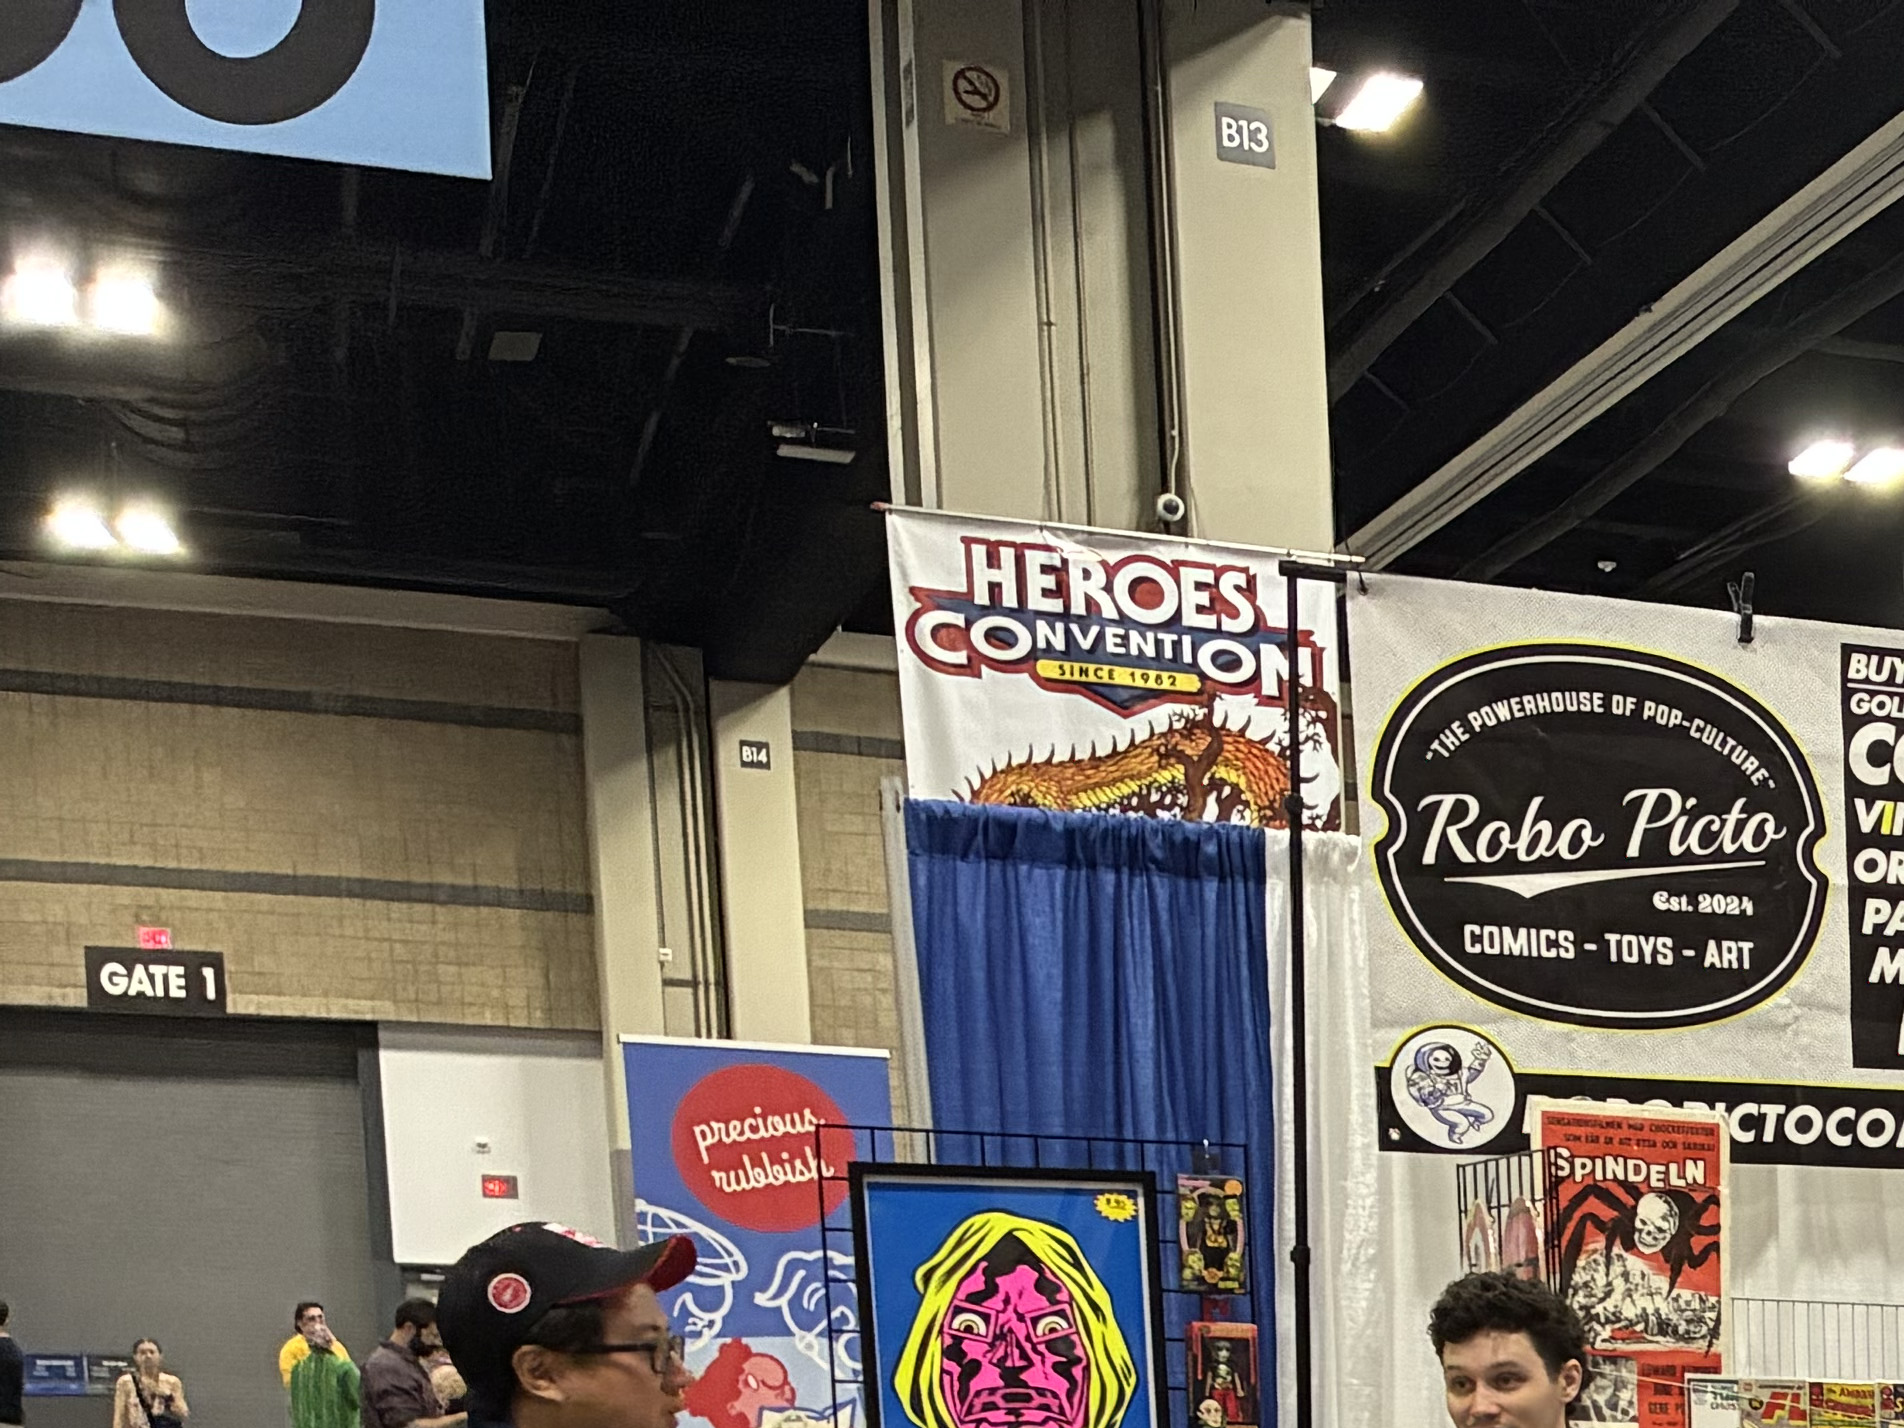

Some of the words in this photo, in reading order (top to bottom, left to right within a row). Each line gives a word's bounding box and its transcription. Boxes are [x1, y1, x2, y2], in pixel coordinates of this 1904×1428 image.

[1221, 116, 1270, 154] B13
[970, 542, 1258, 634] HEROES
[911, 607, 1314, 698] CONVENTION
[1058, 663, 1115, 682] SINCE
[1130, 670, 1178, 687] 1982
[1465, 690, 1604, 736] POWERHOUSE
[1611, 691, 1634, 716] OF
[742, 745, 767, 765] B14
[1416, 793, 1604, 866] Robo
[1622, 785, 1788, 859] Picto
[1652, 890, 1693, 914] Est.
[1463, 923, 1576, 958] COMICS
[1605, 932, 1674, 966] TOYS
[1703, 939, 1754, 971] ART
[100, 961, 186, 999] GATE
[202, 966, 216, 1000] 1
[694, 1104, 826, 1163] precious
[711, 1155, 834, 1194] rubbish
[1553, 1146, 1706, 1189] SPINDELN
